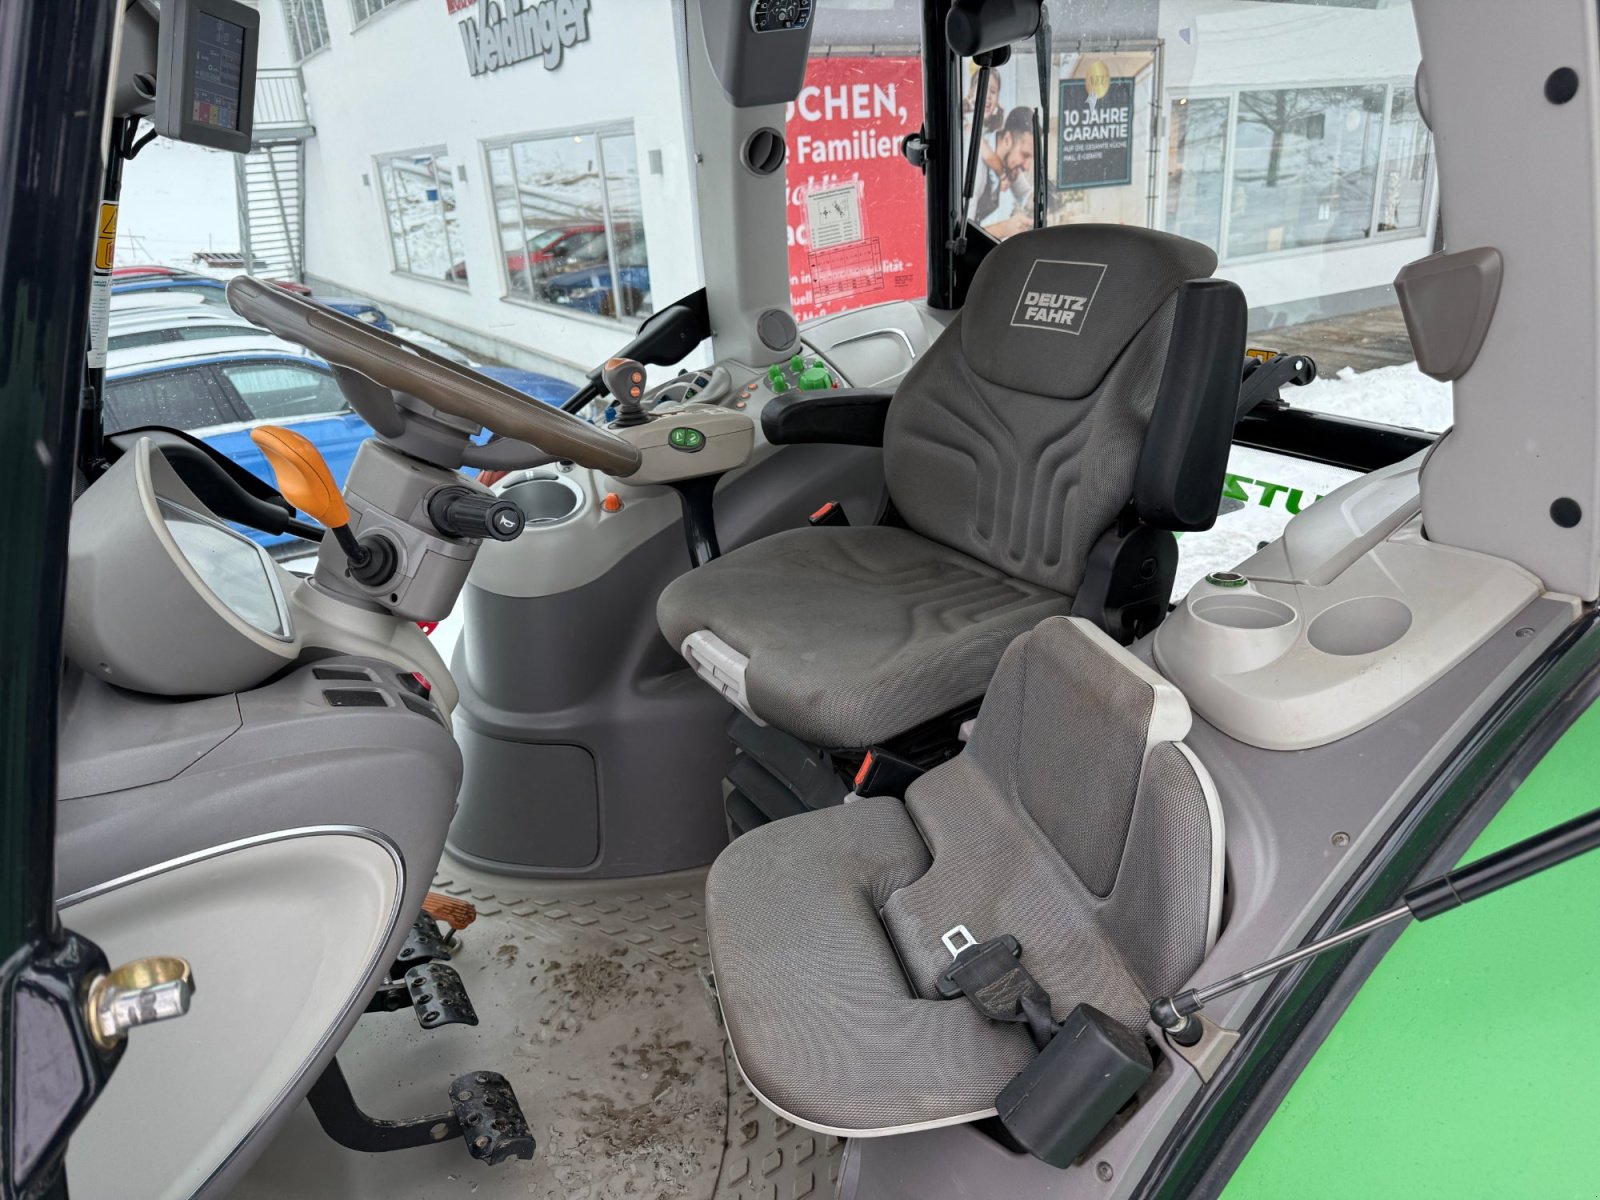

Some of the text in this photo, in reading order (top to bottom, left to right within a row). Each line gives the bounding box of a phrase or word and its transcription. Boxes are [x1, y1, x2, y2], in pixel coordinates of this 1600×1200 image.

[1063, 107, 1129, 126] 10 JAHRE
[1063, 123, 1128, 142] GARANTIE
[1024, 291, 1088, 311] DEUTZ
[1024, 306, 1076, 325] FAHR
